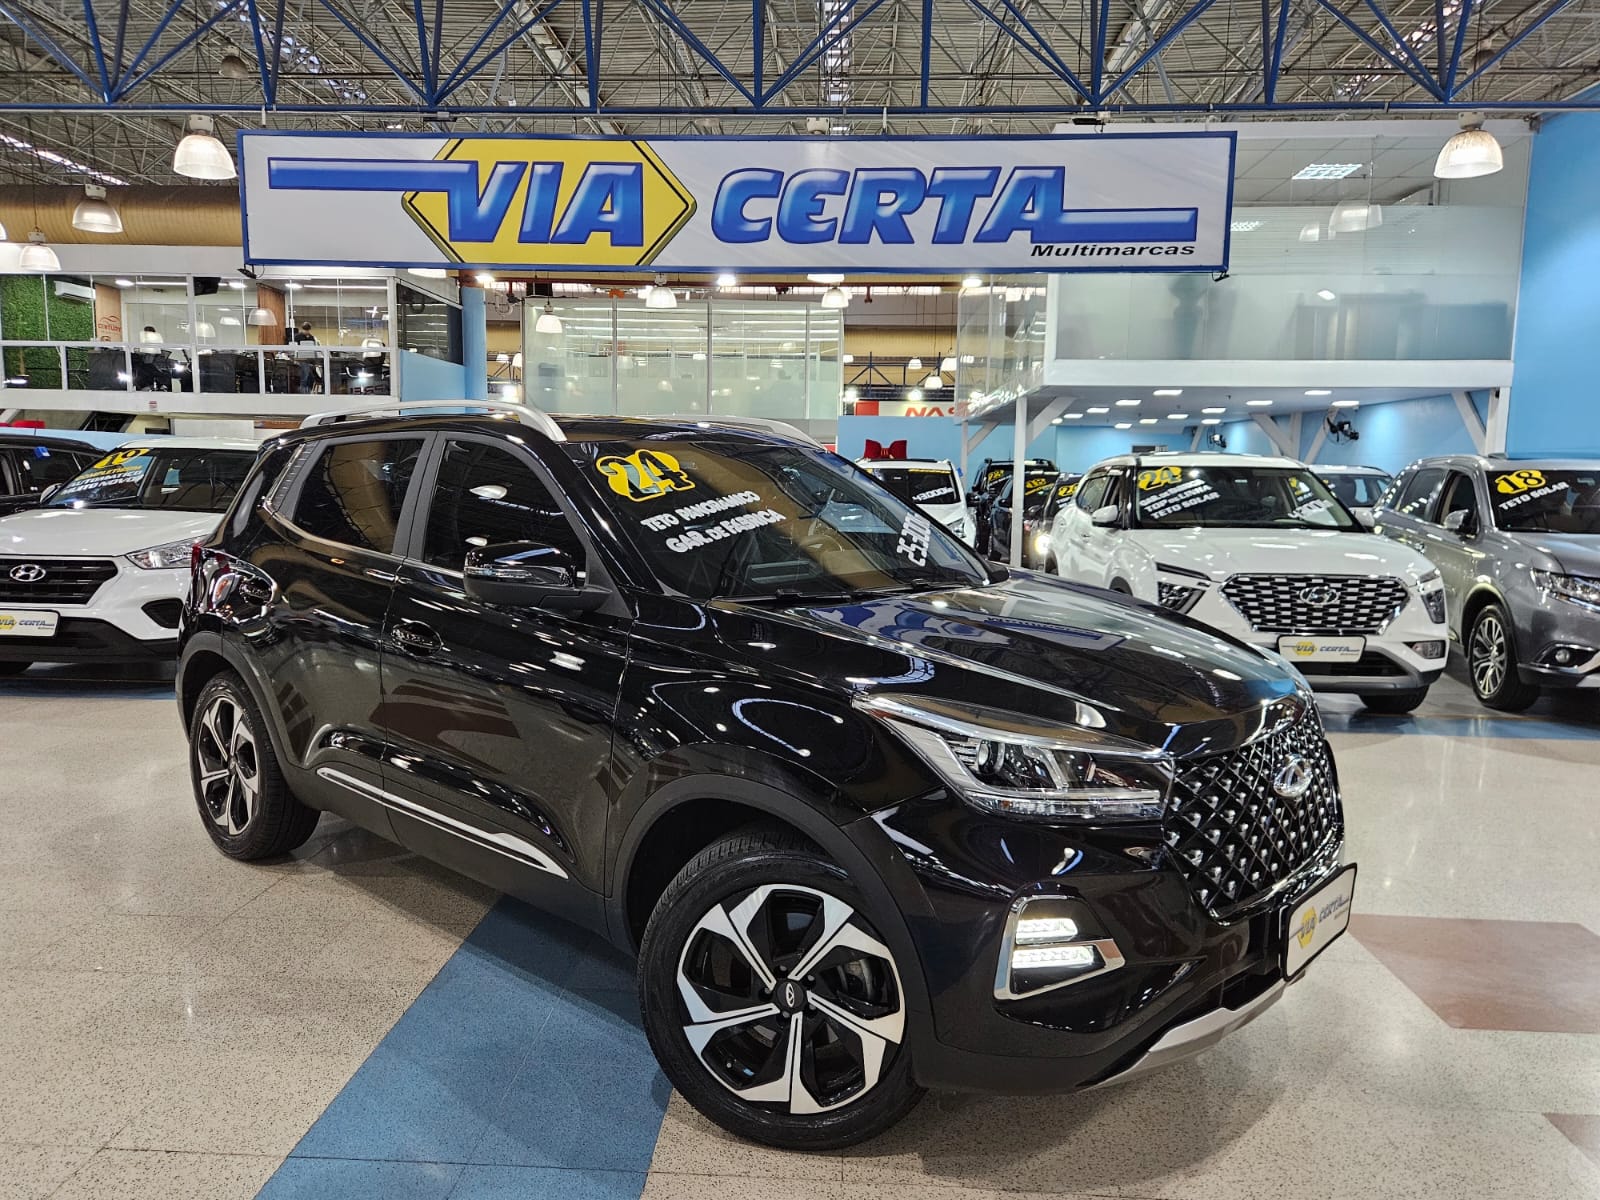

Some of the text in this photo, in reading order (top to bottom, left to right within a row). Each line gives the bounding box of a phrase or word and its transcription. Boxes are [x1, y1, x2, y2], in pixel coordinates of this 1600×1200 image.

[447, 161, 1066, 247] VIA CERTA
[1030, 243, 1196, 258] Multimarcas
[596, 449, 696, 502] 24
[1495, 469, 1546, 494] 18
[1150, 491, 1221, 519] TETO SOLAR
[1499, 481, 1570, 510] TETO SOLAR
[640, 512, 680, 532] TETO
